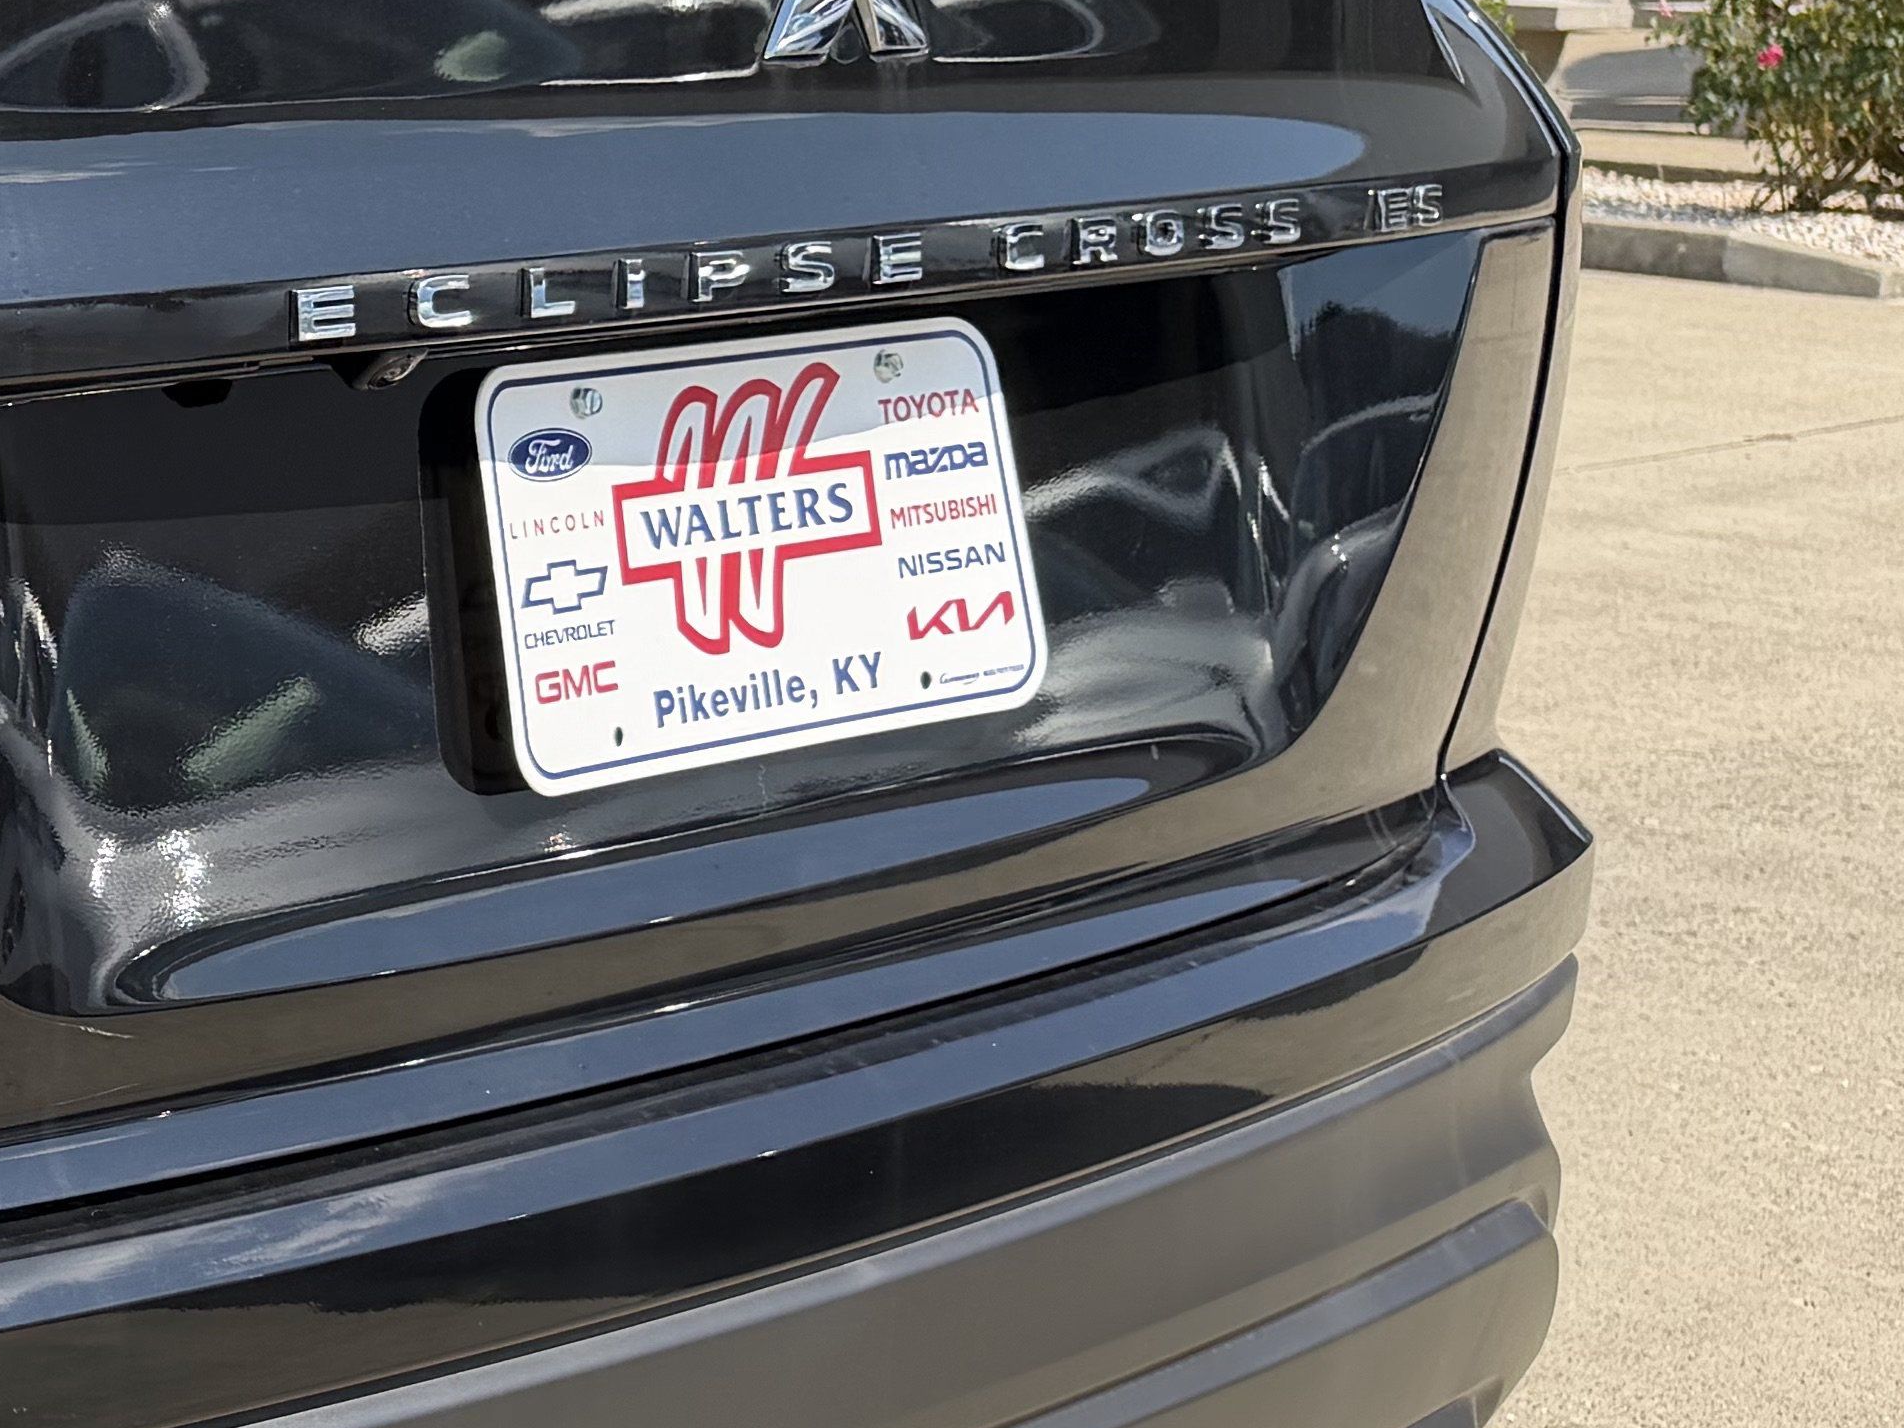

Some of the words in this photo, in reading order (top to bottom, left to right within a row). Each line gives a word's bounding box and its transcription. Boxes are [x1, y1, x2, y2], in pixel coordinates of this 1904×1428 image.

[292, 232, 924, 342] ECLIPSE
[994, 197, 1301, 271] CROSS
[878, 389, 979, 424] TOYOTA
[525, 438, 575, 474] Ford
[510, 509, 605, 540] LINCOLN
[640, 482, 853, 550] WALTERS
[891, 493, 997, 530] MITSUBISHI
[899, 541, 1006, 579] NISSAN
[907, 590, 1015, 640] KIA
[524, 619, 616, 650] CHEVROLET
[535, 660, 619, 705] GMC
[653, 668, 819, 729] Pikeville,
[832, 651, 882, 695] KY
